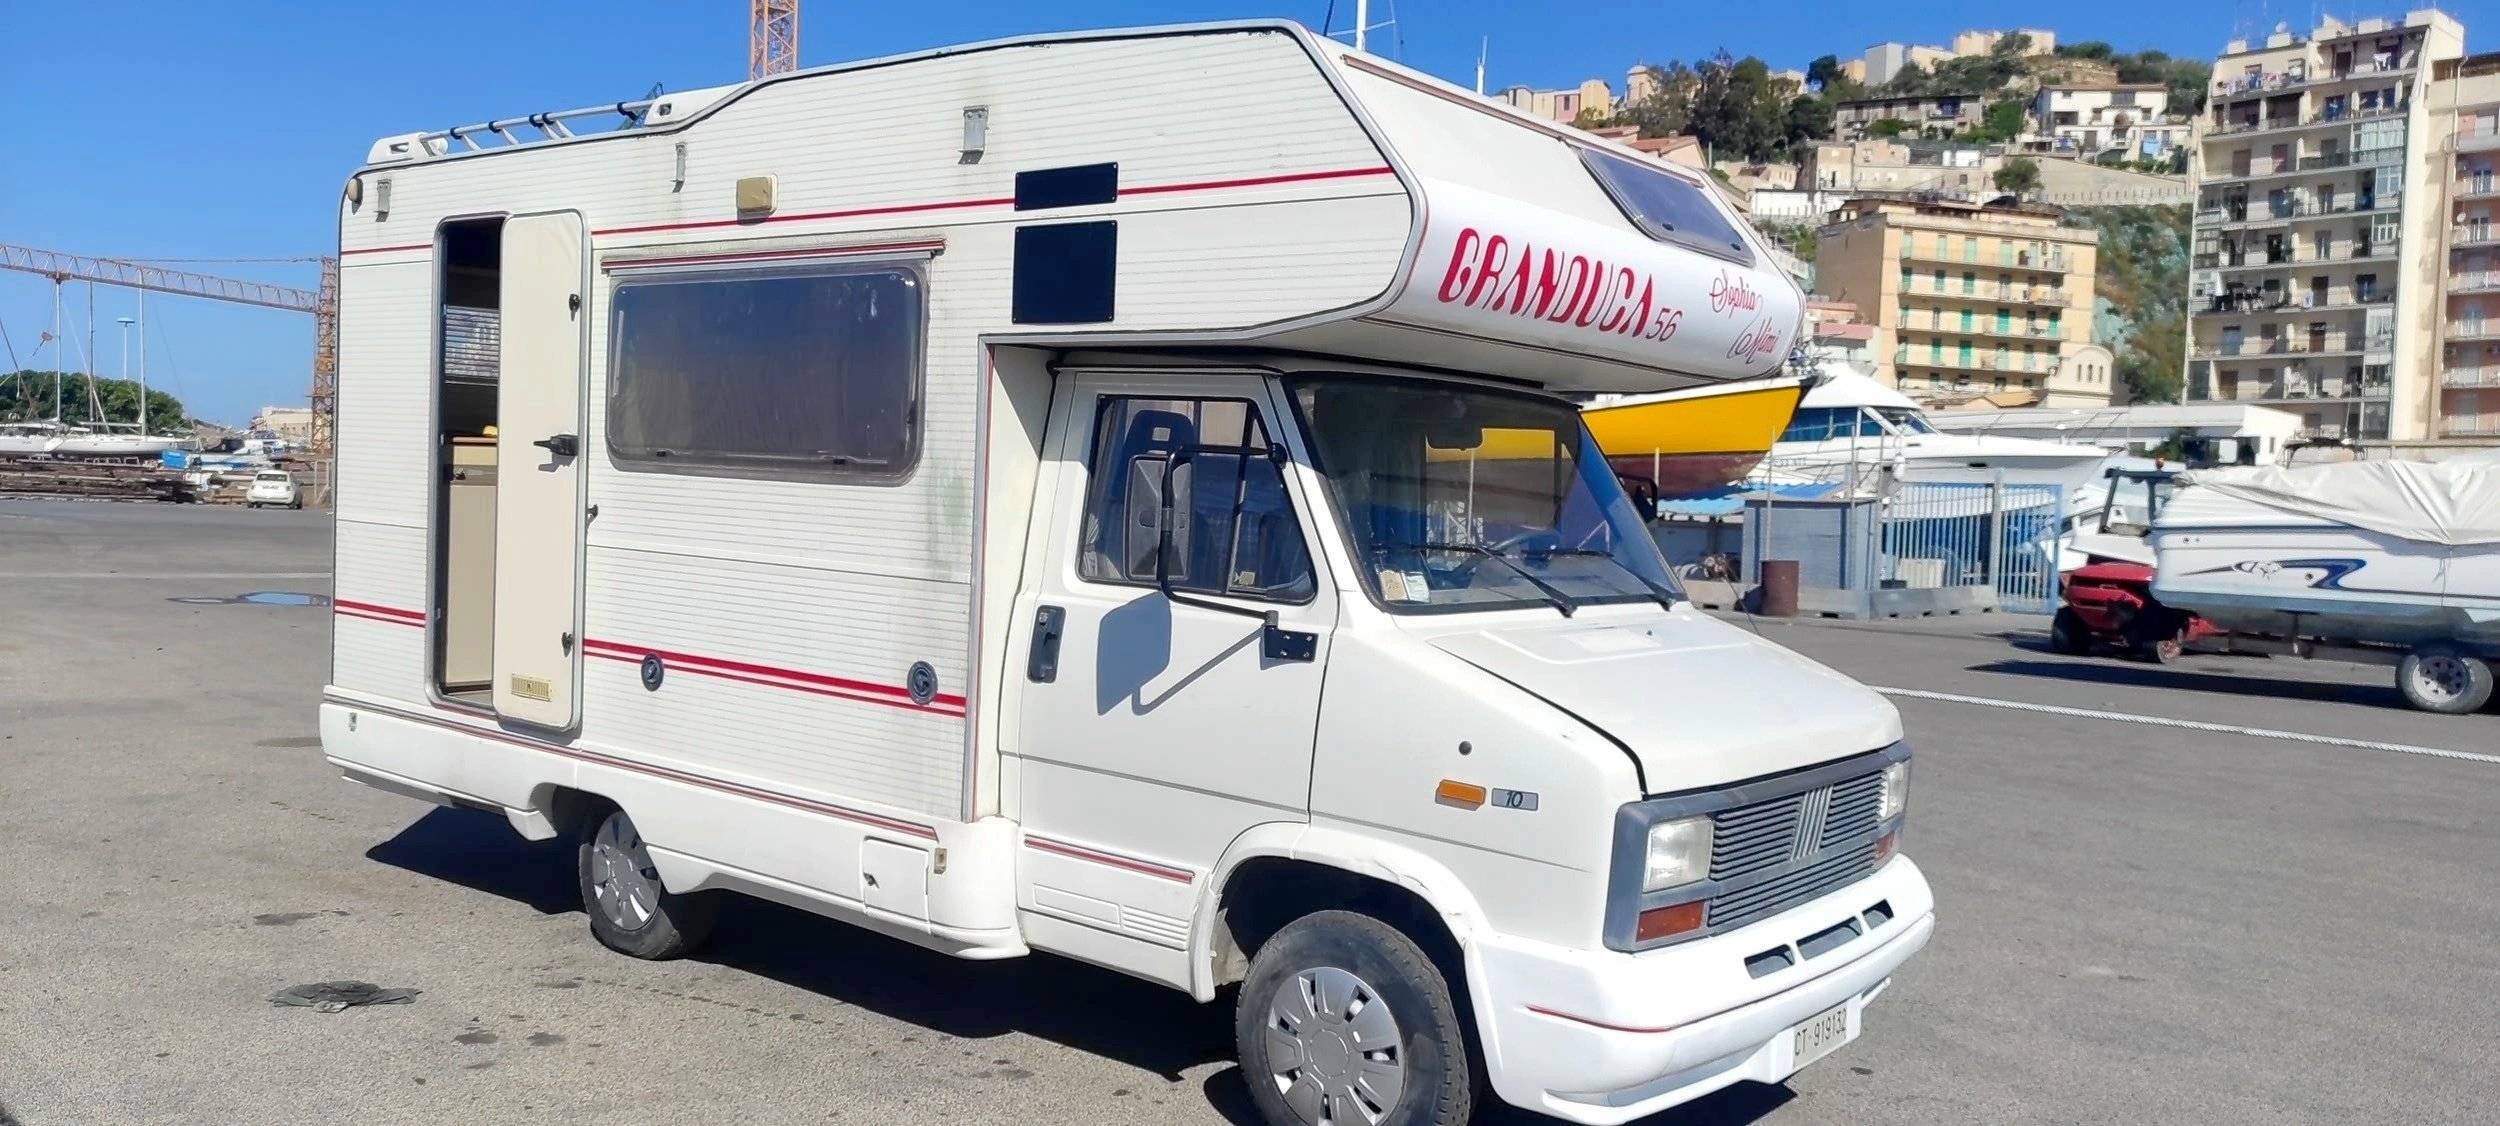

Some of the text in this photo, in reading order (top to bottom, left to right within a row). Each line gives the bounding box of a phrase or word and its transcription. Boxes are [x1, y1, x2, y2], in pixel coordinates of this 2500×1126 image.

[1438, 228, 1683, 342] GRANDUCA 56
[1709, 268, 1756, 319] Sophia
[1505, 791, 1524, 808] 10
